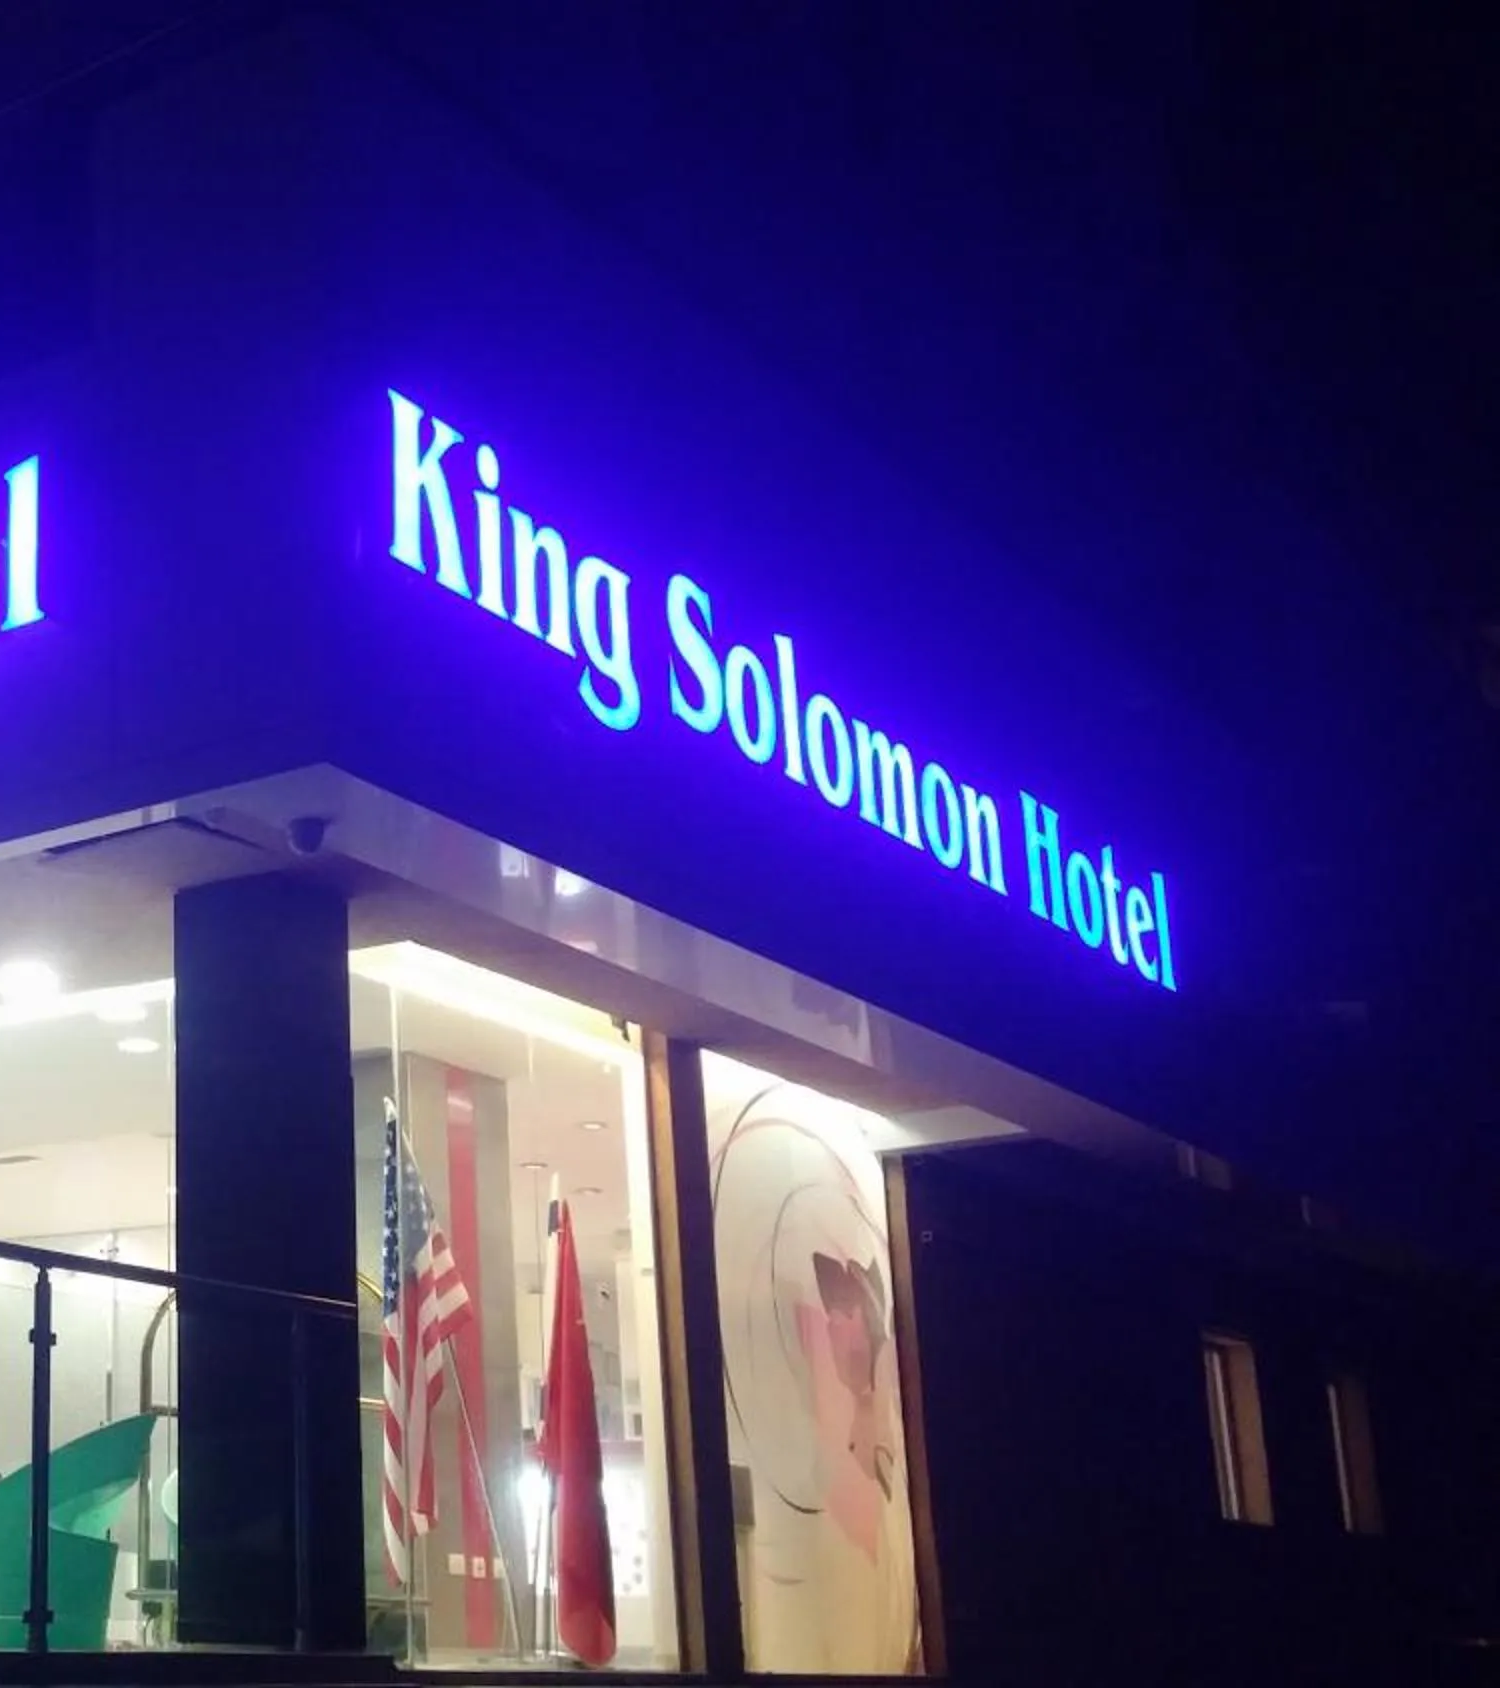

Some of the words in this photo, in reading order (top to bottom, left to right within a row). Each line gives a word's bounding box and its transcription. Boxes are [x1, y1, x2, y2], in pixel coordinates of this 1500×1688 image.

[386, 387, 641, 732] King
[665, 572, 1009, 897] Solomon
[1018, 790, 1177, 991] Hotel
